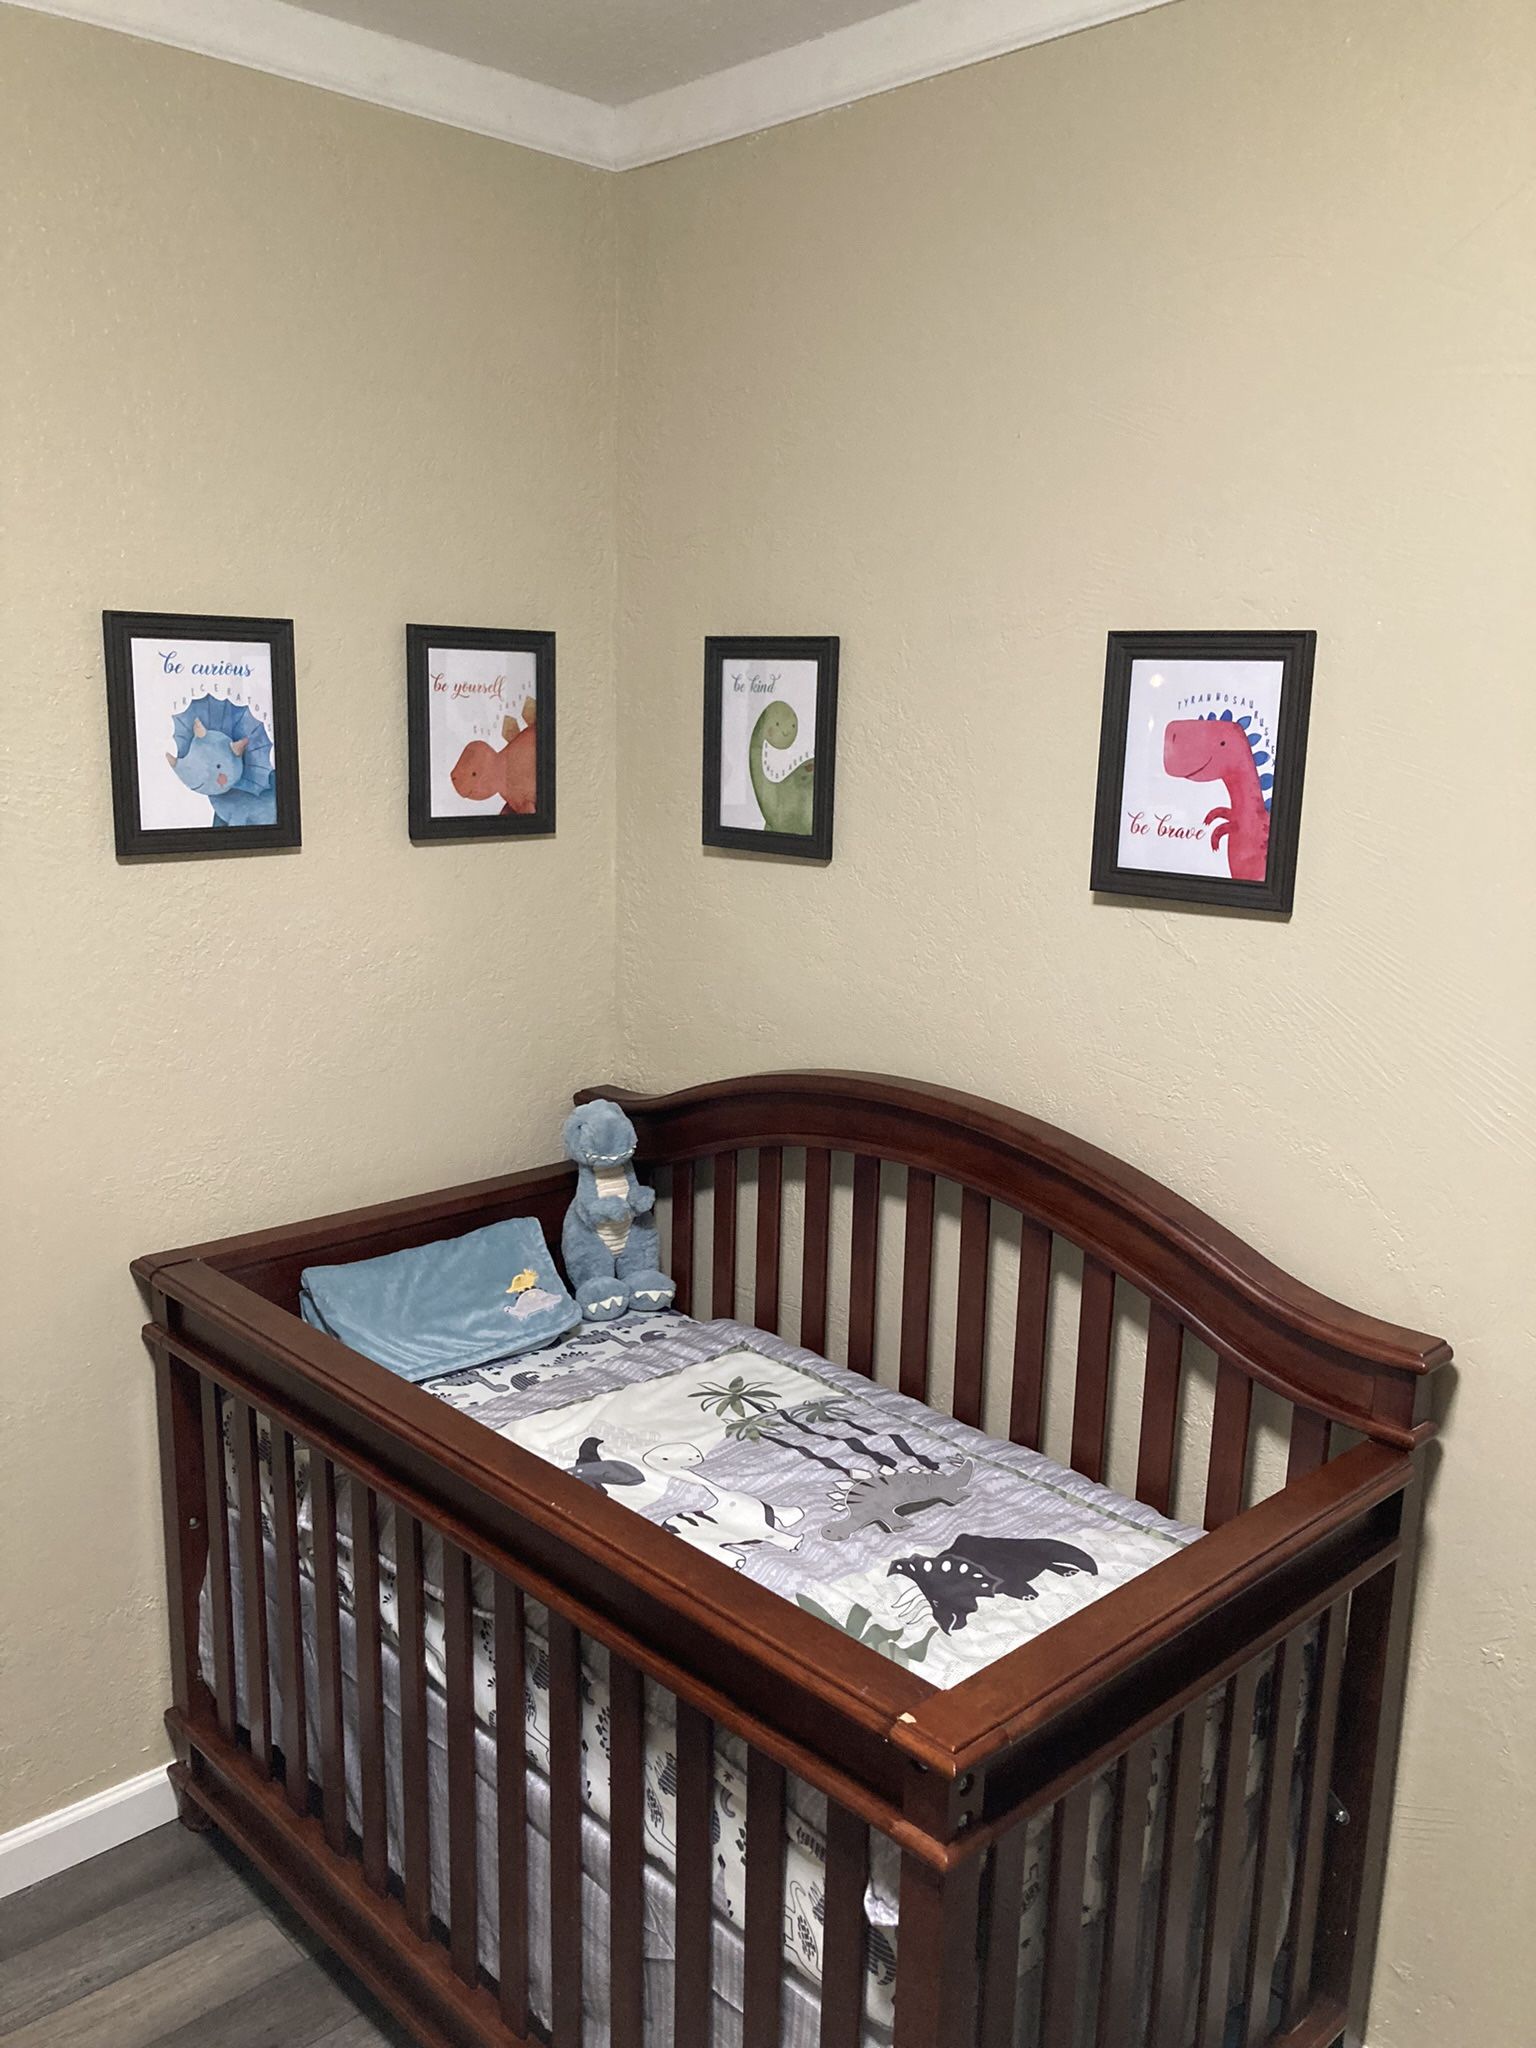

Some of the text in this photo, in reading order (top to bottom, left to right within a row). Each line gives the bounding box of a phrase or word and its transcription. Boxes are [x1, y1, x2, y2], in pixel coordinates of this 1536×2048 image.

[158, 651, 254, 677] be curious
[431, 673, 447, 692] be
[452, 675, 506, 701] yourself
[731, 673, 782, 693] be kind
[1128, 811, 1206, 840] be brave
